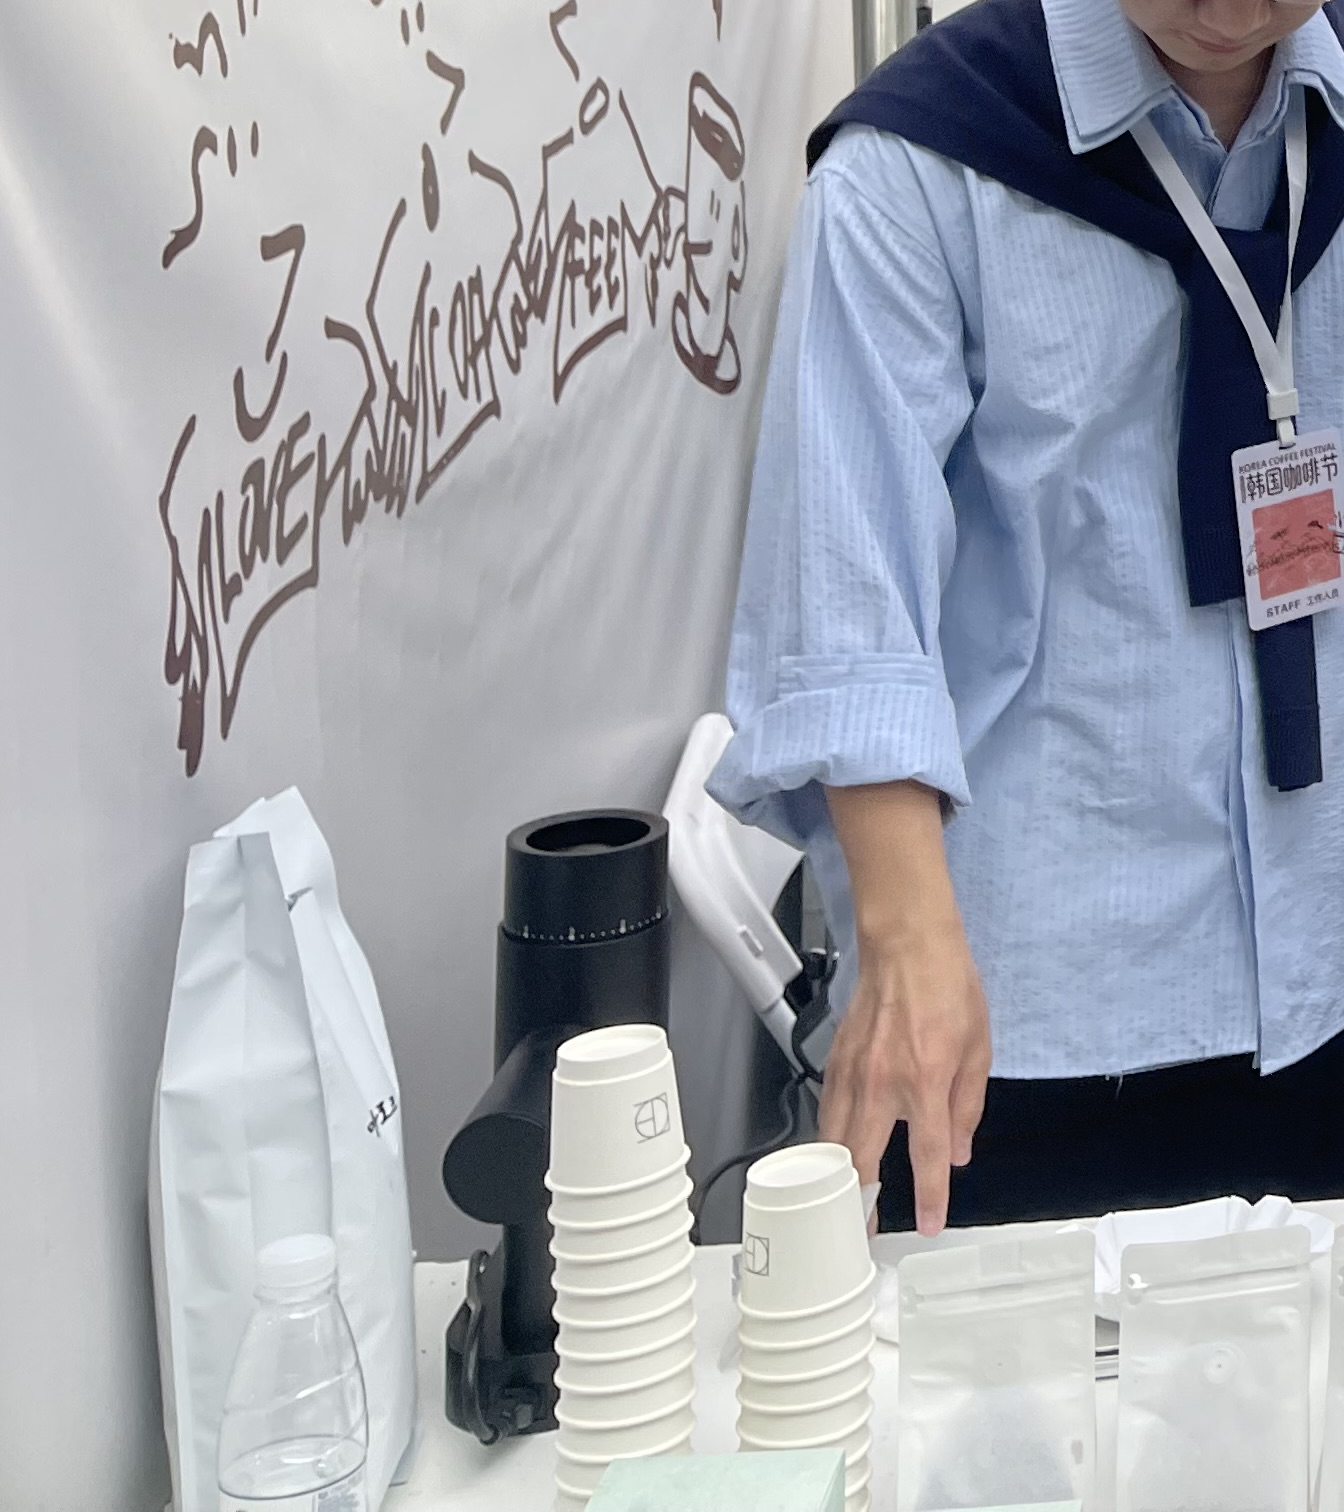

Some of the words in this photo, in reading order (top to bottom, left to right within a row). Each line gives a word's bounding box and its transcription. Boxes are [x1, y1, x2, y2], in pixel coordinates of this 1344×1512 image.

[1246, 452, 1338, 502] 韩国咖啡节
[1266, 599, 1301, 618] STAFF
